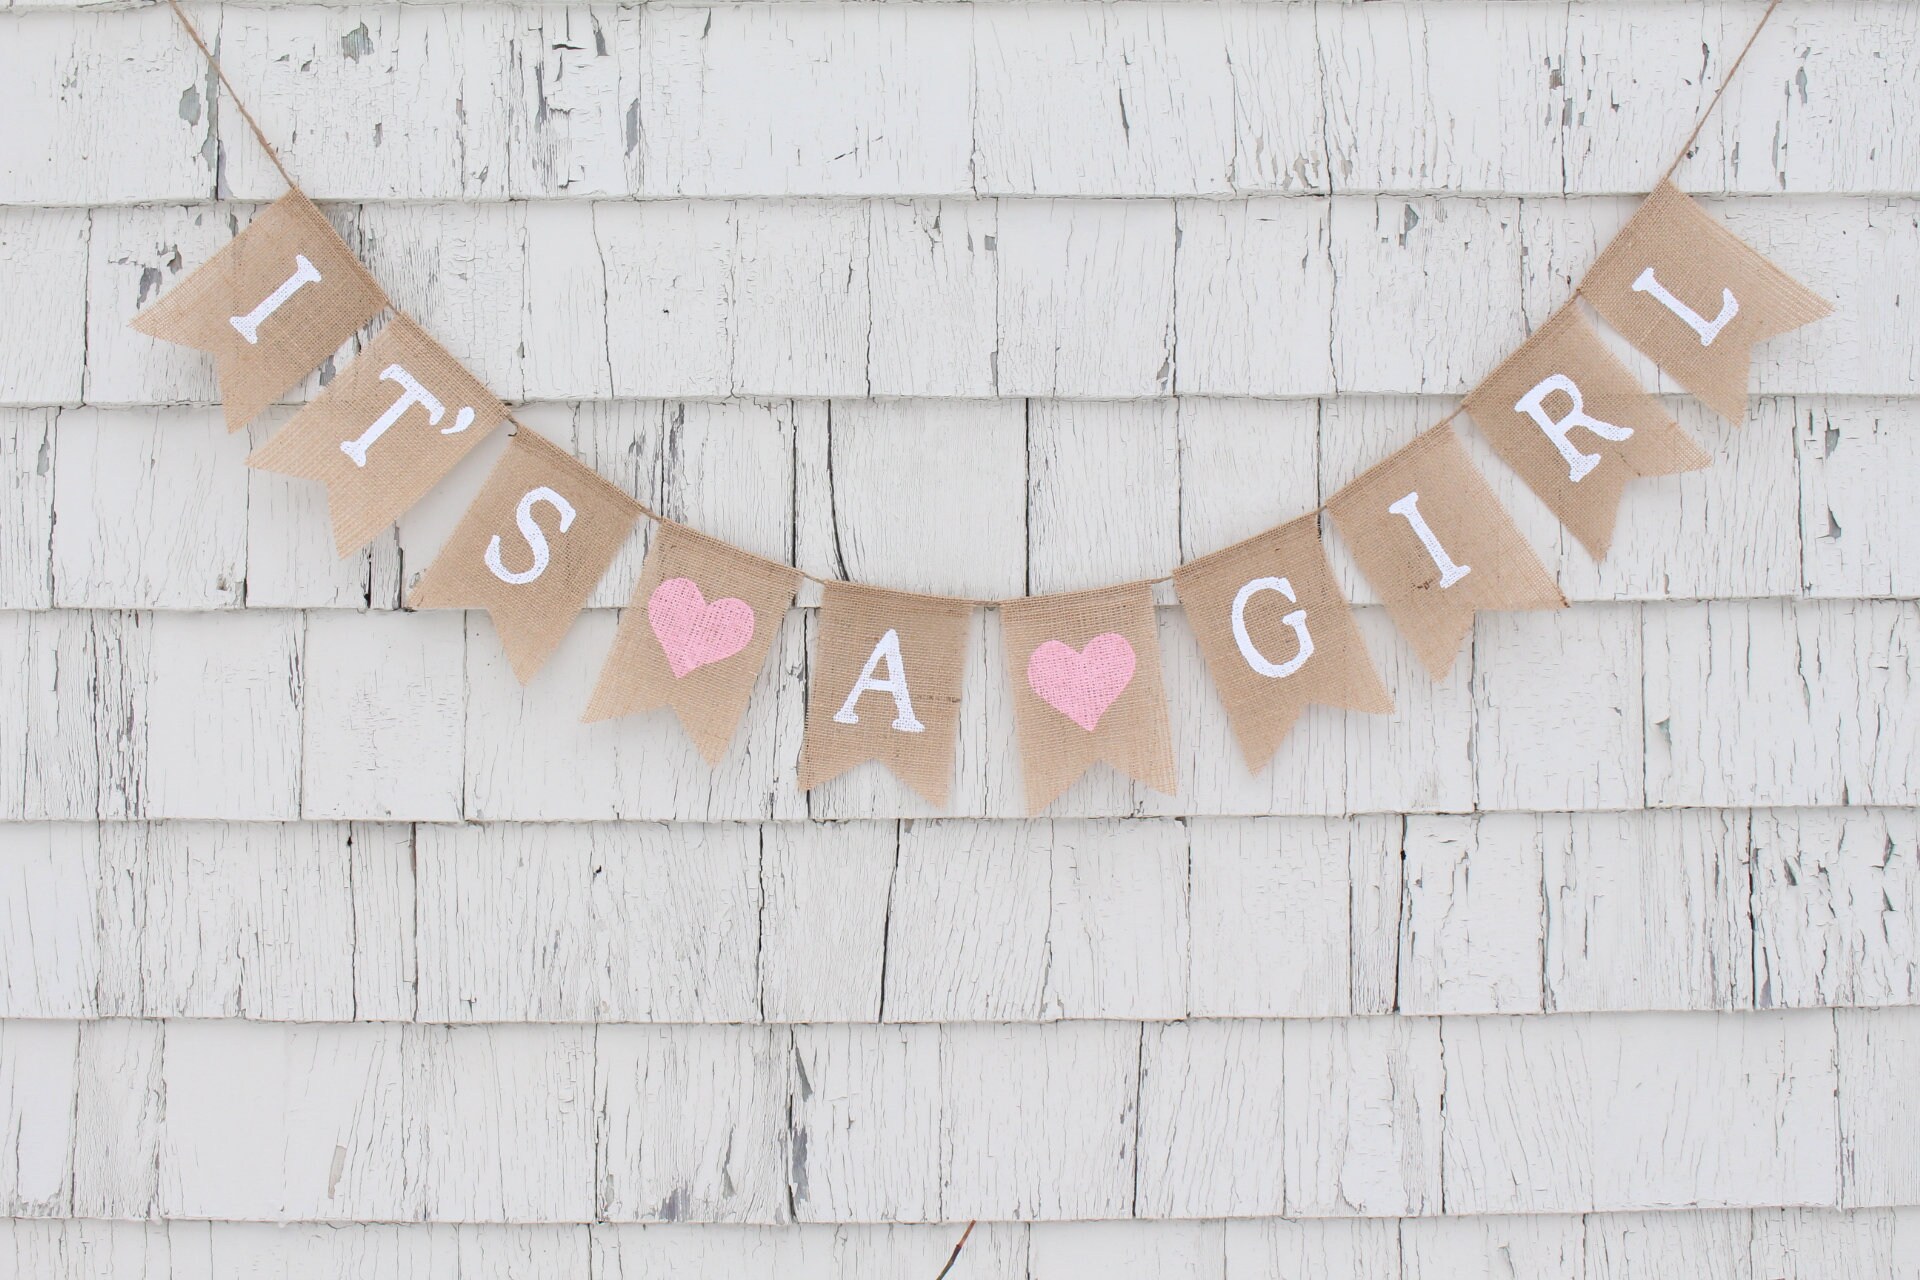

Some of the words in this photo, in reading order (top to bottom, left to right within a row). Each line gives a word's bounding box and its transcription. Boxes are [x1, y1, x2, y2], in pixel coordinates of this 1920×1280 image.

[228, 254, 577, 585] IT'S
[832, 628, 926, 734] A
[1230, 267, 1741, 679] GIRL
